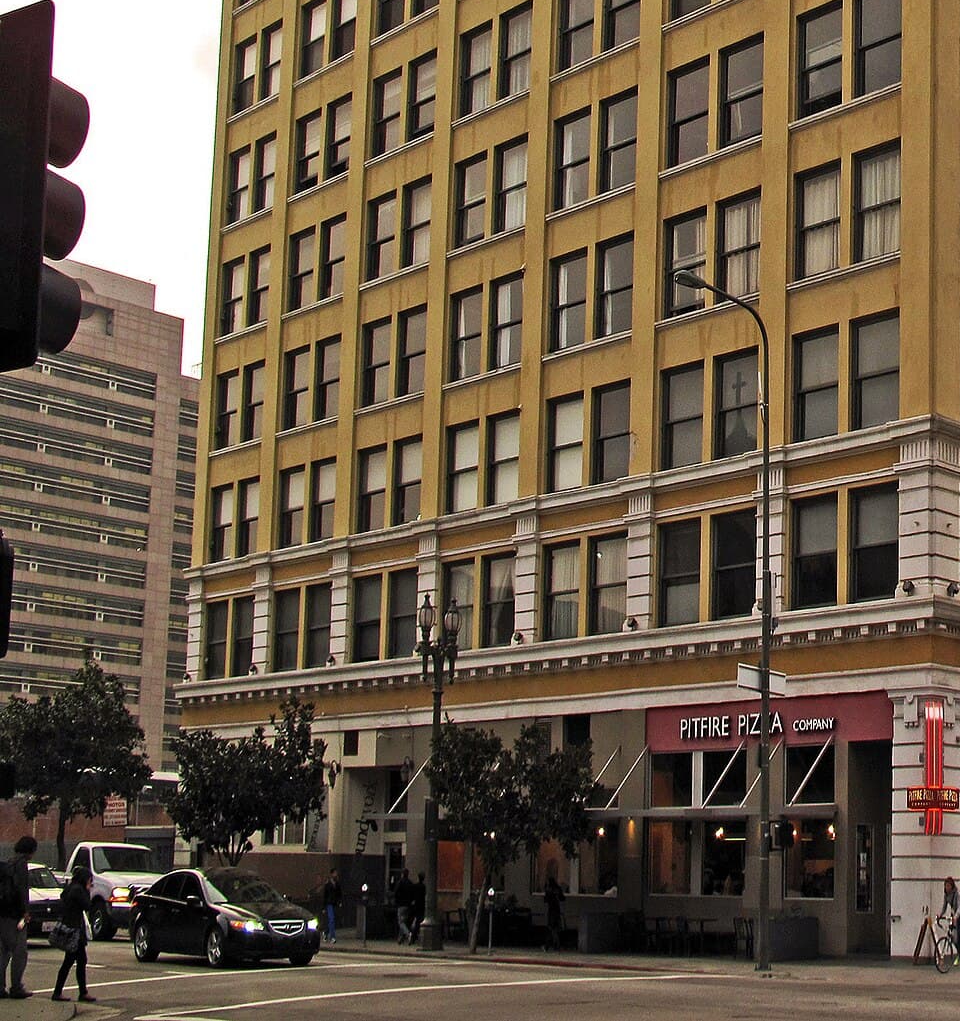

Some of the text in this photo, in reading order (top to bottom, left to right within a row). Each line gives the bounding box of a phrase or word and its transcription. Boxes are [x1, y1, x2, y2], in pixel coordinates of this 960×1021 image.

[680, 711, 834, 739] PITFIRE PIZA COMPANY
